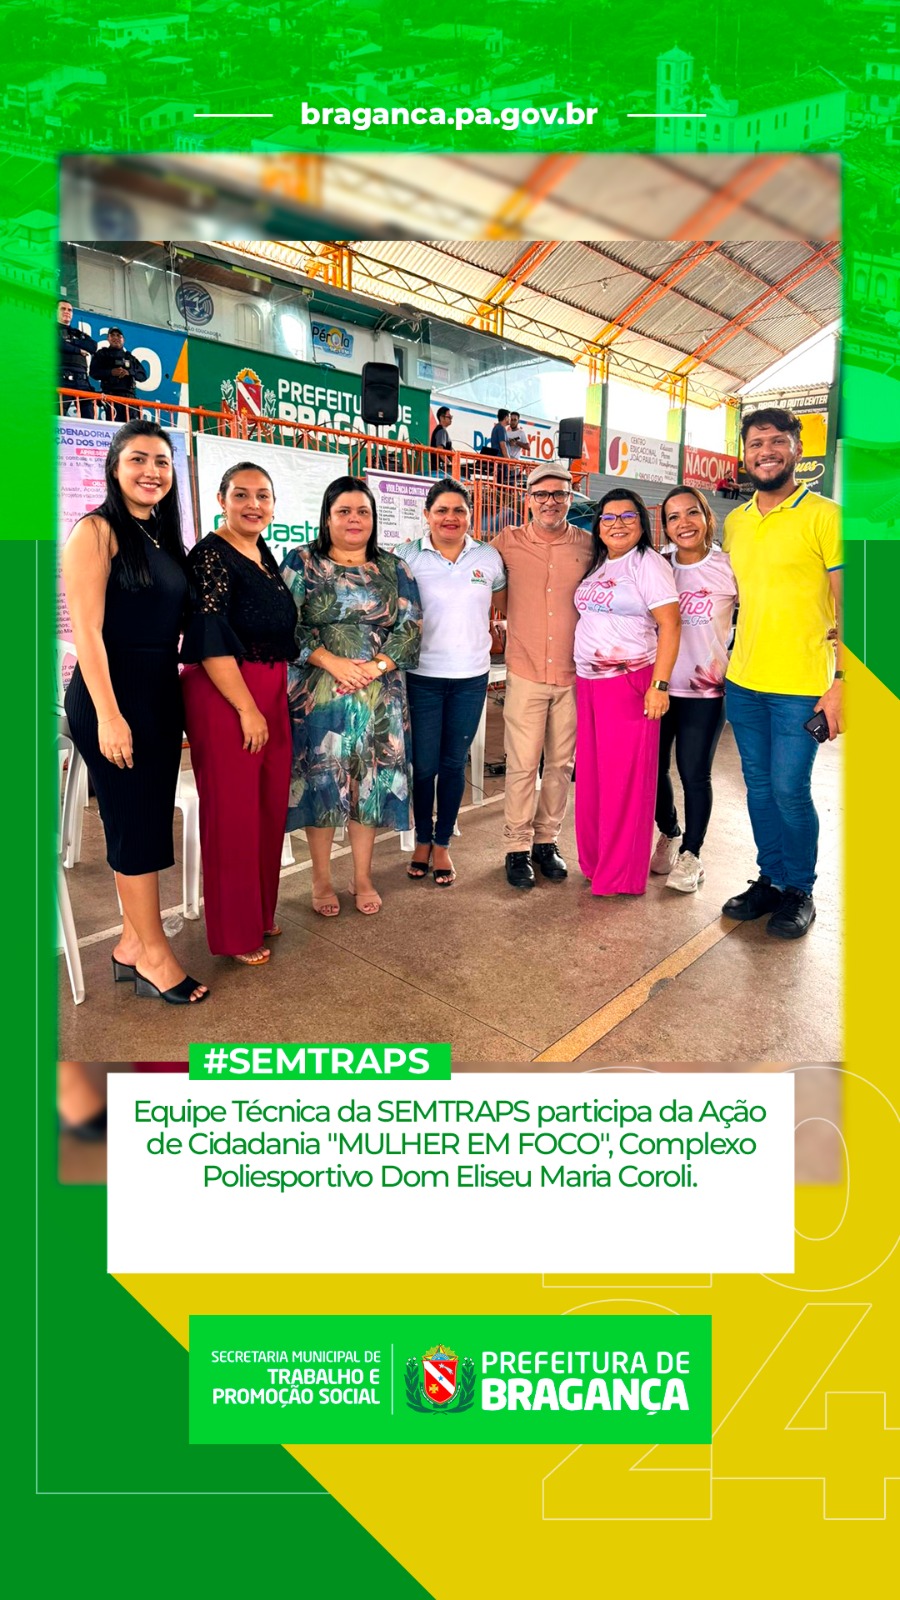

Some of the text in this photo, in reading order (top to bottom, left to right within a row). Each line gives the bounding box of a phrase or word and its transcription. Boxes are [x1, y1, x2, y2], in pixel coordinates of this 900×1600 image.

[803, 395, 829, 406] CENTER
[76, 438, 94, 447] DOS
[630, 436, 647, 446] CENTRO
[629, 444, 658, 458] EDUCACIONAL
[385, 483, 408, 495] VIOLÊNCIA
[408, 486, 426, 498] CONTRA
[381, 493, 396, 506] FÍSICA
[403, 498, 418, 508] MORAL
[383, 529, 401, 539] SEXUAL
